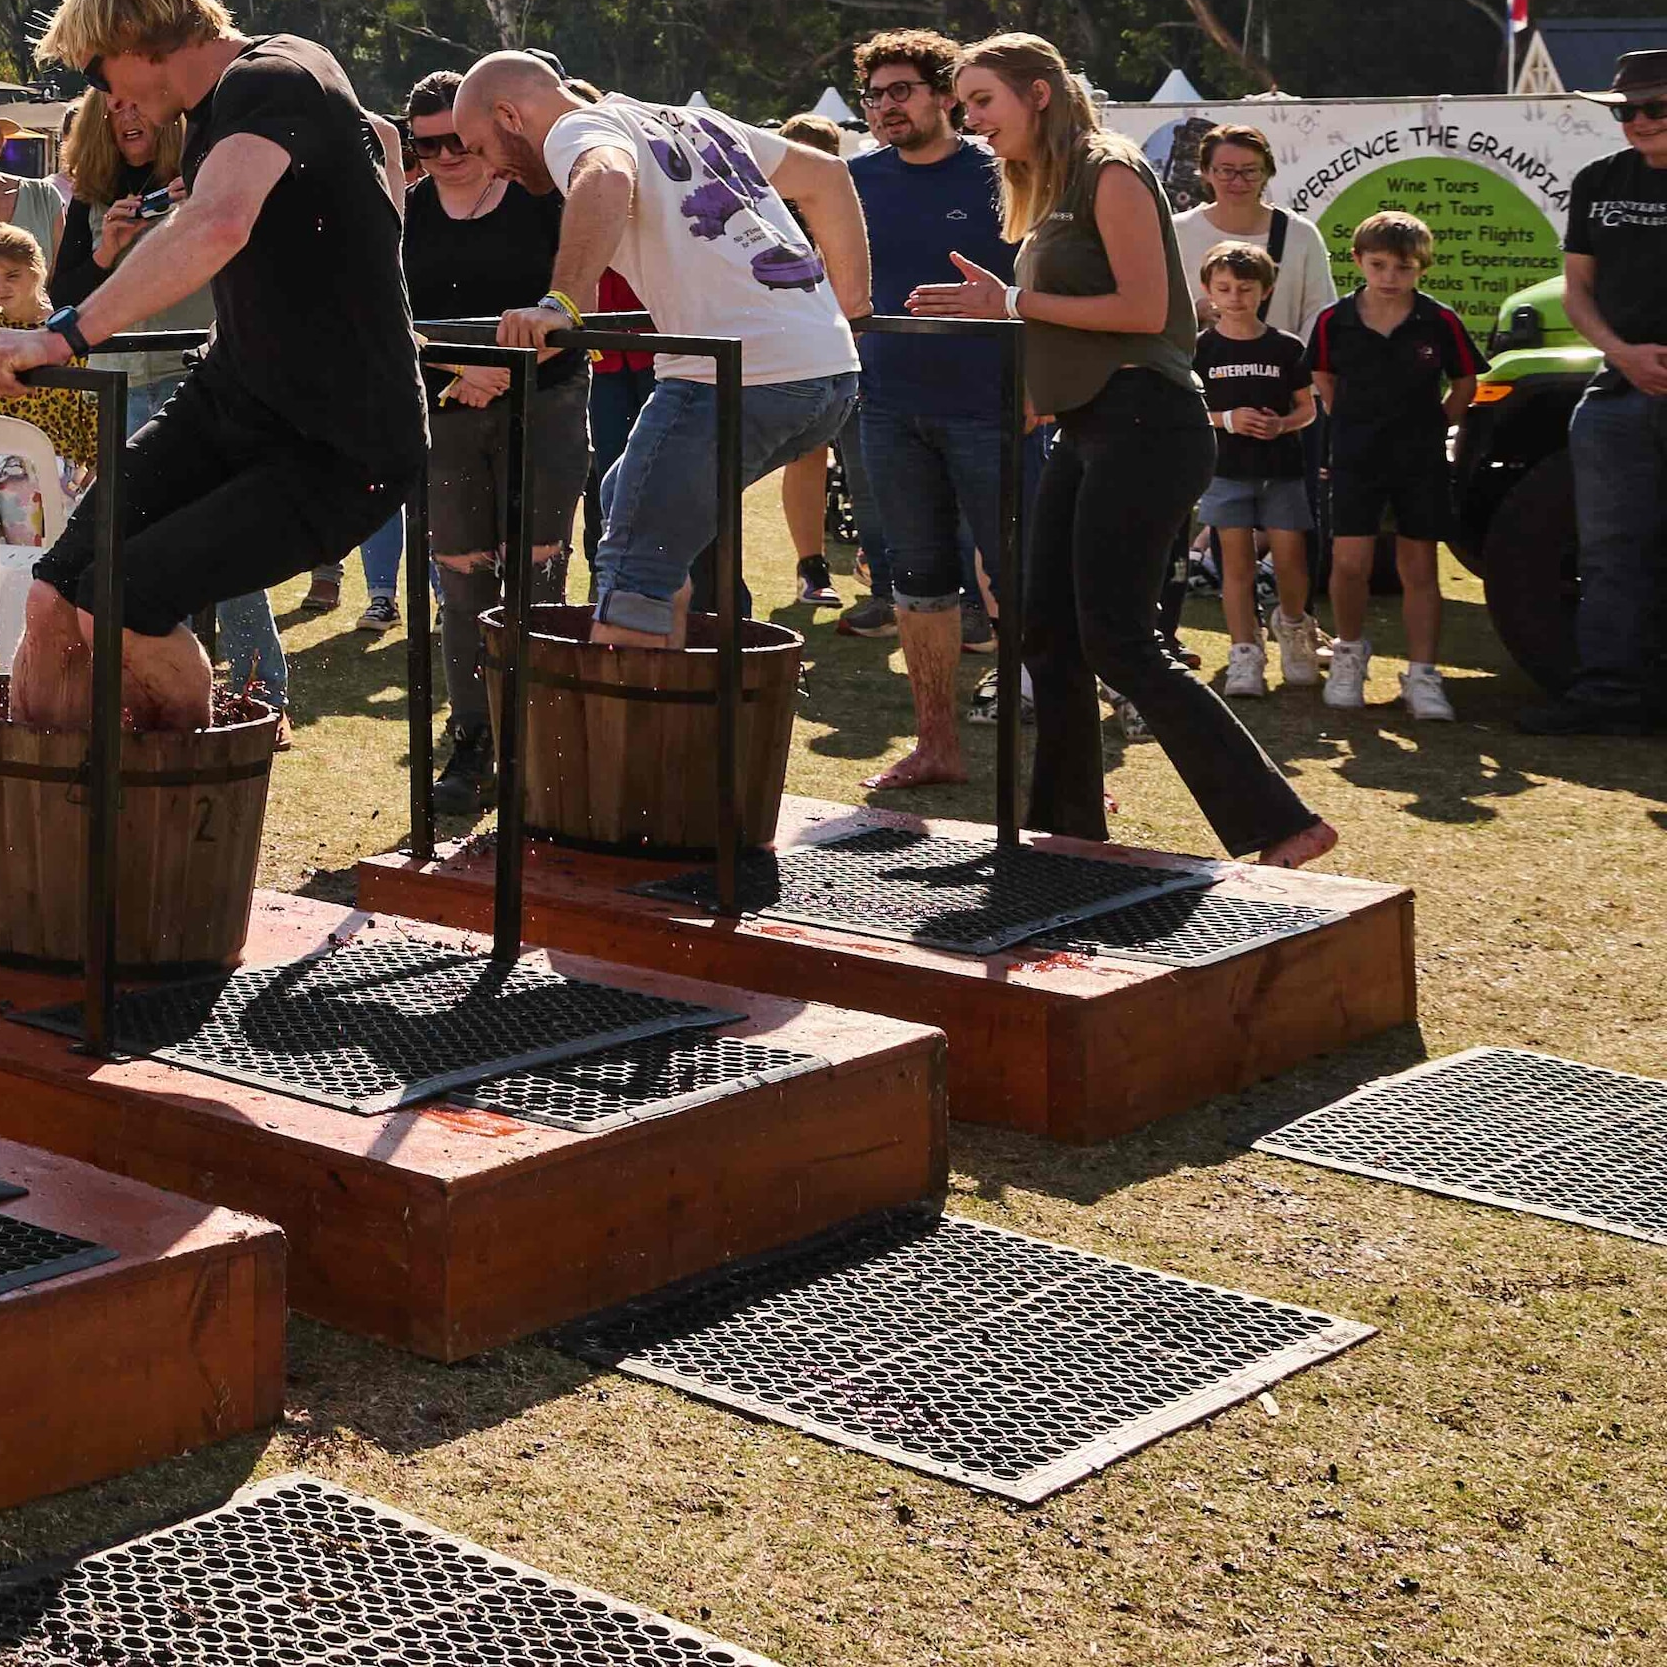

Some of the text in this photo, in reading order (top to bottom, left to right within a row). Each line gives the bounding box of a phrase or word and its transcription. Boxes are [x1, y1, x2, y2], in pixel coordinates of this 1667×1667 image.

[1291, 125, 1570, 215] XPERIENCE THE GRAMPIA
[1387, 178, 1480, 194] Wine Tours
[1414, 200, 1441, 216] Art
[1448, 201, 1494, 217] Tours
[1478, 225, 1535, 247] Flights
[1461, 250, 1559, 270] Experiences
[1419, 276, 1463, 291] Peaks
[1470, 276, 1509, 292] Trail
[1208, 363, 1281, 380] CATERPILLAR
